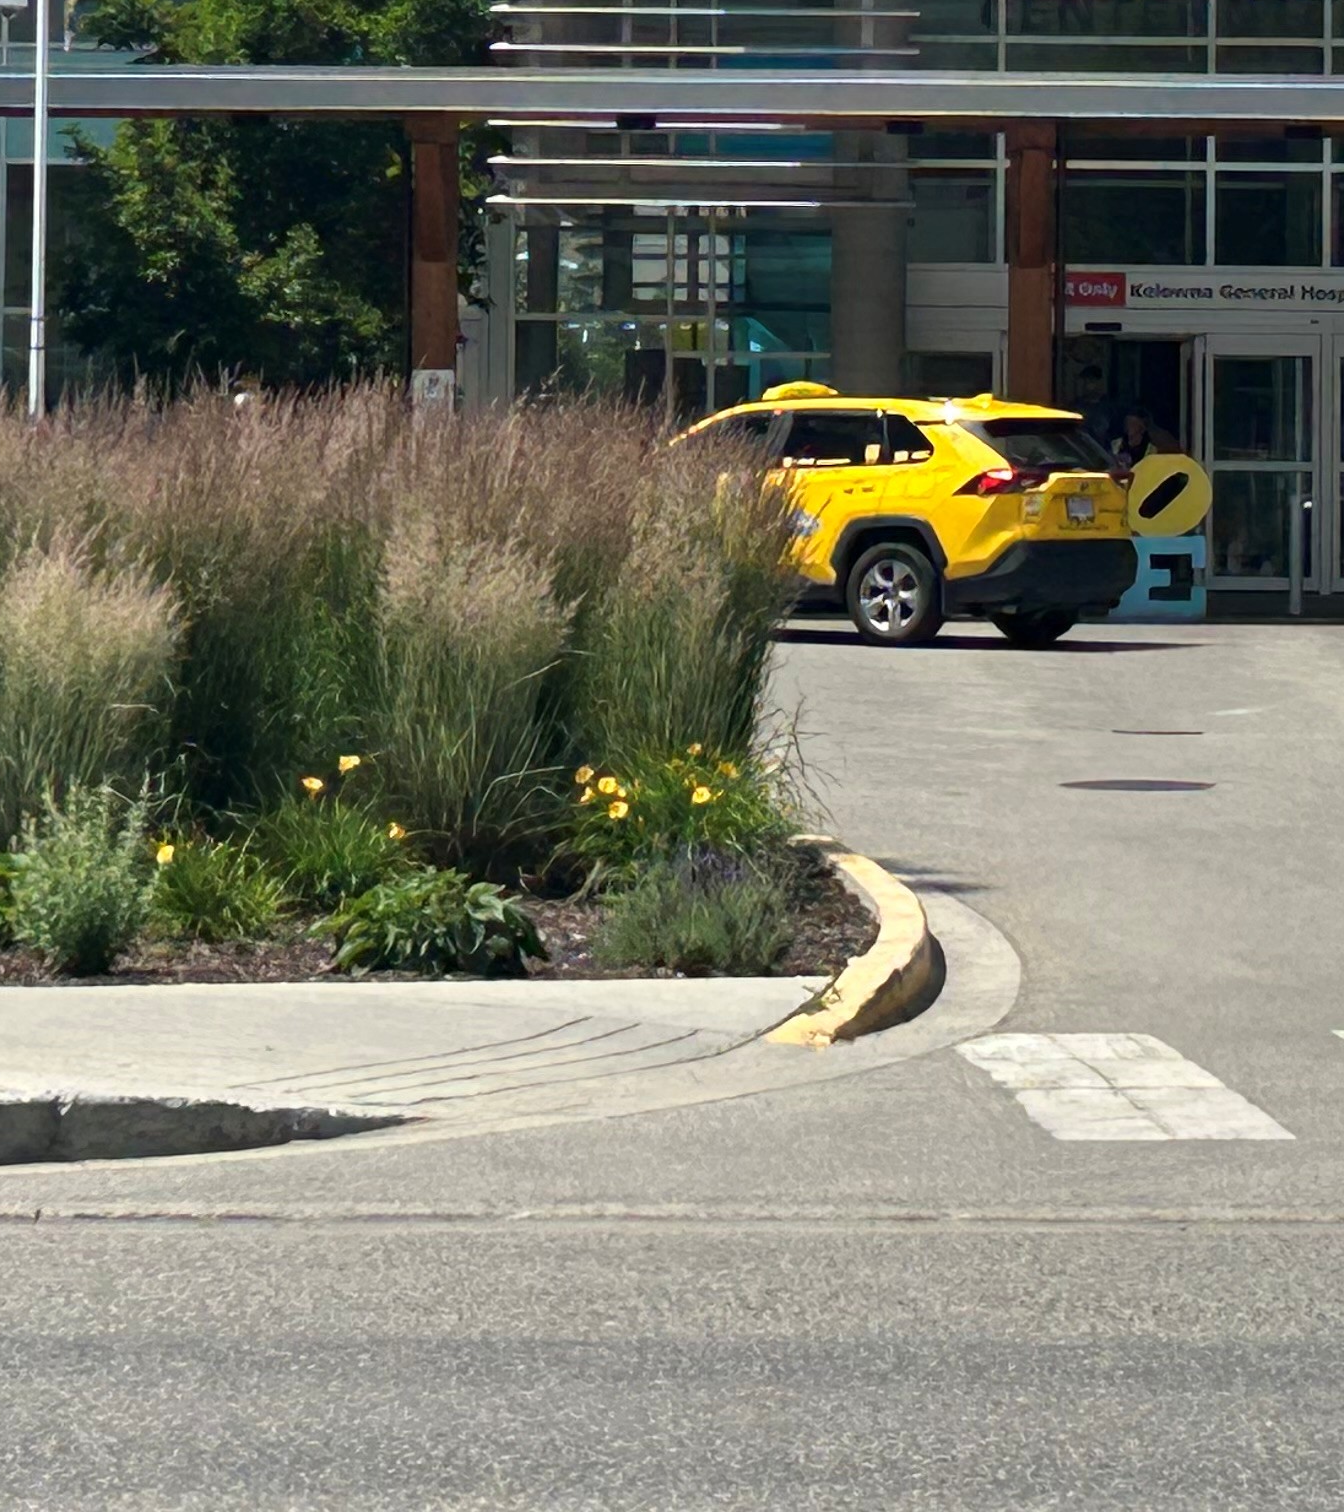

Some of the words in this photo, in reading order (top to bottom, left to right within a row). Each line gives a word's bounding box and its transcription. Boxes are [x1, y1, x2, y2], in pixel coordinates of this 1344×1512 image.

[1078, 281, 1119, 301] Only
[1129, 282, 1213, 300] Kelowna
[1219, 284, 1295, 301] General
